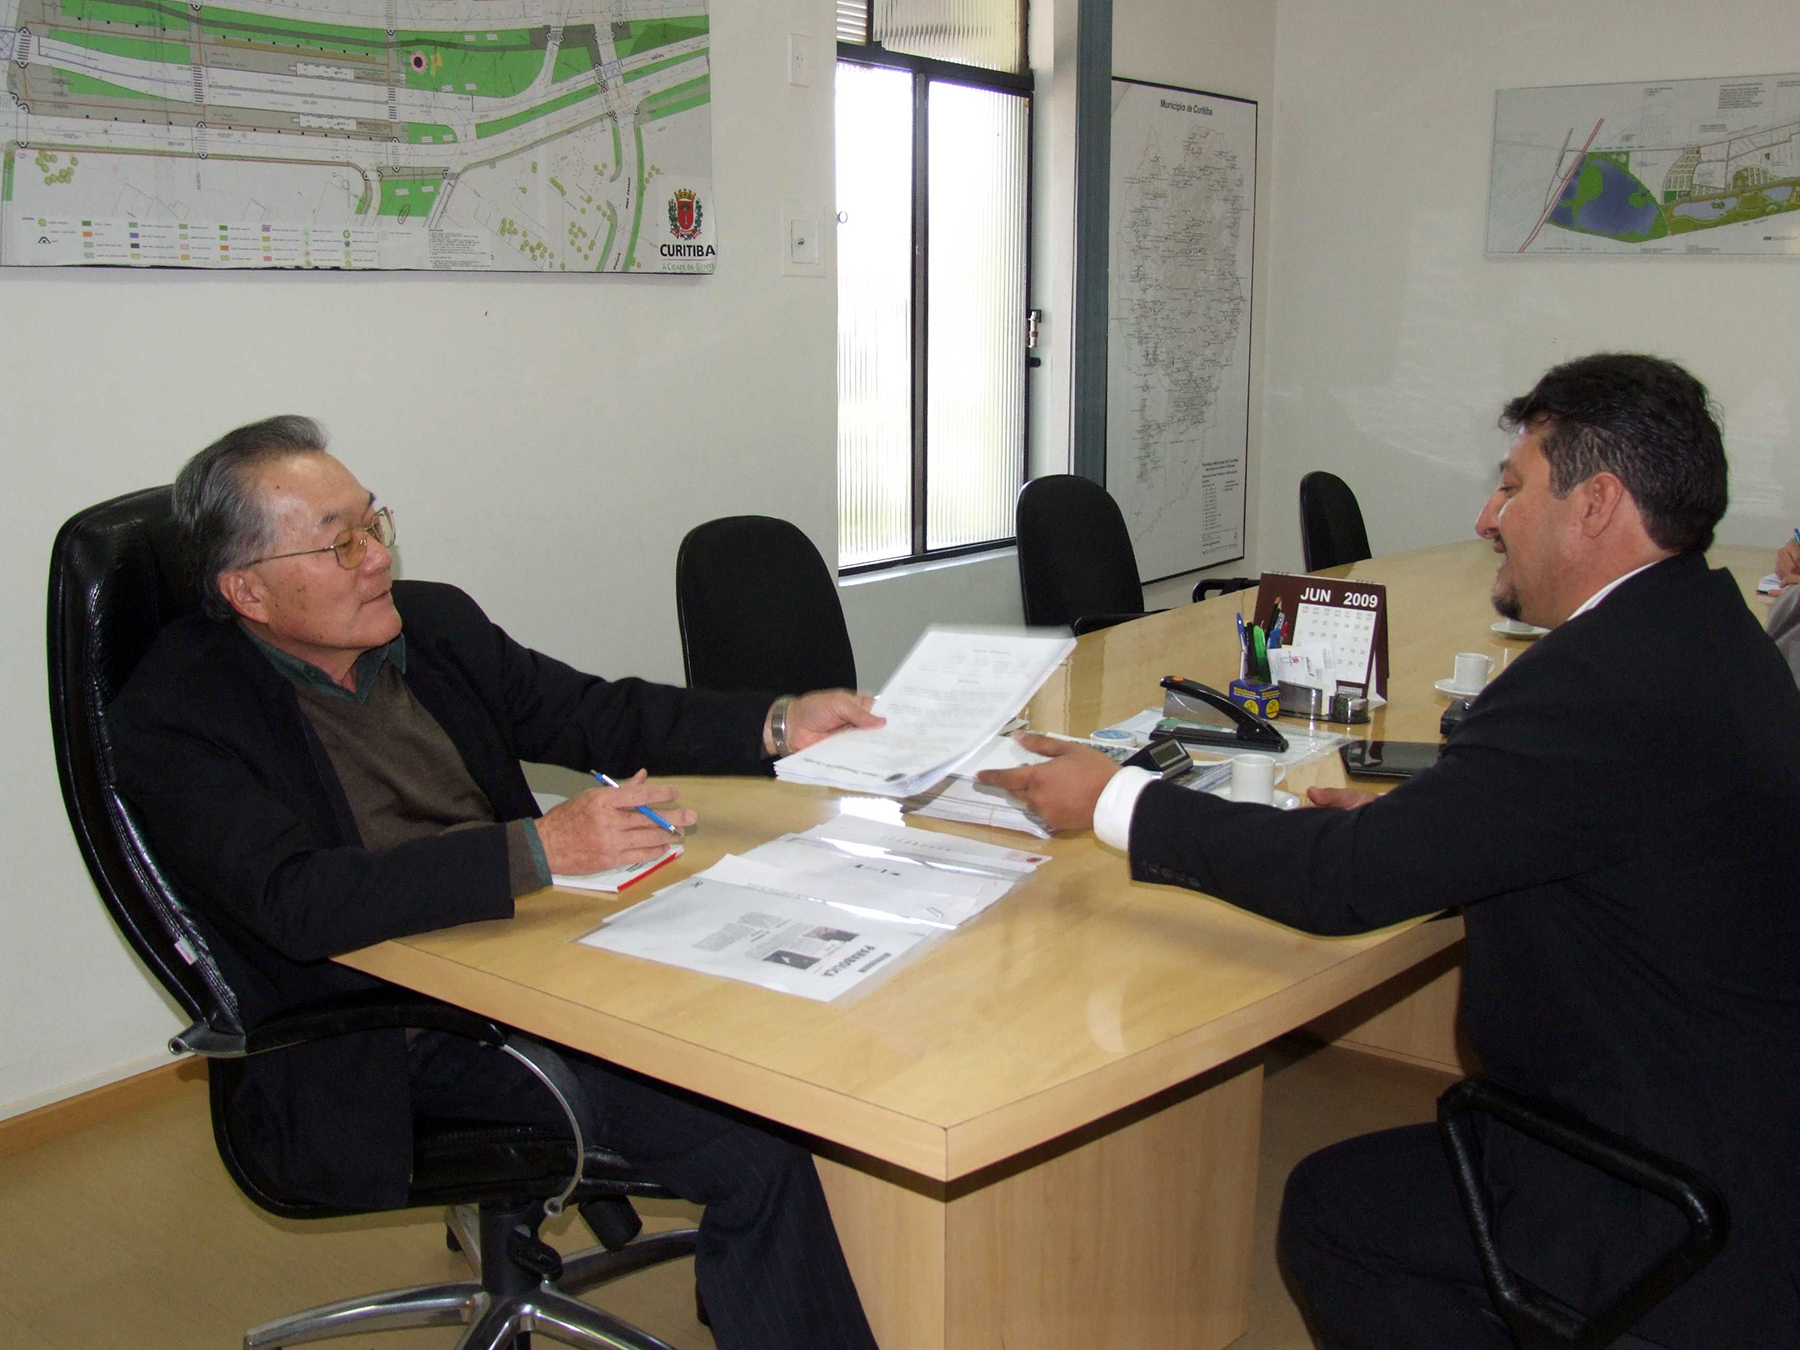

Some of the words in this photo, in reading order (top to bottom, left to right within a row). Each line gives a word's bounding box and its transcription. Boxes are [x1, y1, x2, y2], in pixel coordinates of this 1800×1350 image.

[1186, 103, 1193, 113] de
[1193, 104, 1213, 116] Curitiba
[660, 244, 716, 257] CURITIBA
[1300, 587, 1331, 603] JUN
[1342, 591, 1378, 608] 2009
